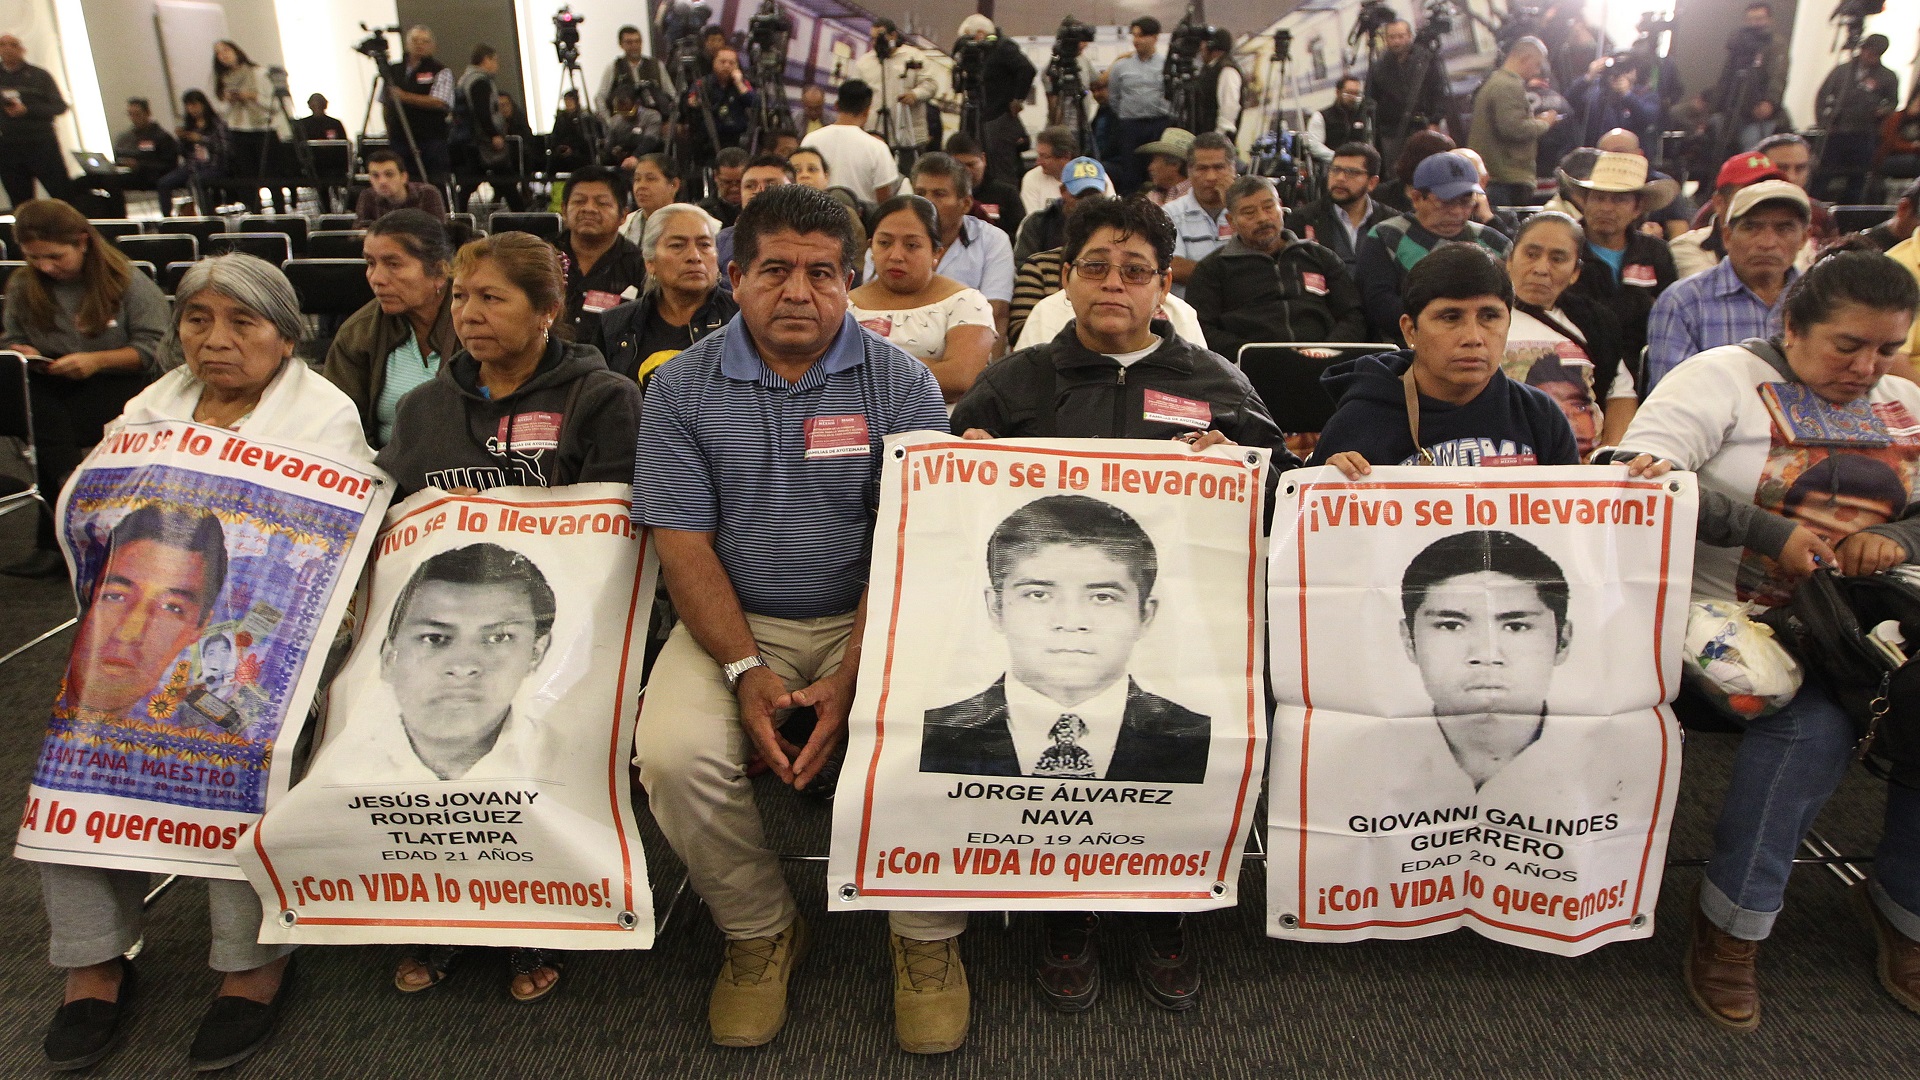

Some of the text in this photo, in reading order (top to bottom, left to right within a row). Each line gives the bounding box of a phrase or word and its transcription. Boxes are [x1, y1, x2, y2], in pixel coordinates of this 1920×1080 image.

[176, 426, 213, 456] lo
[219, 438, 371, 500] llevaron!
[912, 452, 1246, 502] ¡Vivo se lo llevaron!
[423, 512, 446, 536] se
[458, 506, 488, 533] lo
[498, 508, 637, 540] llevaron!
[1311, 494, 1657, 532] ¡Vivo se lo llevaron!
[46, 744, 236, 787] SANTANA MAESTRO
[71, 770, 84, 780] de
[174, 784, 200, 795] años
[948, 782, 1173, 804] JORGE ÁLVAREZ
[348, 791, 539, 809] JESÚS JOVANY
[45, 801, 78, 834] lo
[370, 808, 523, 826] RODRÍGUEZ
[1022, 809, 1093, 825] NAVA
[1349, 805, 1618, 839] GIOVANNI GALINDES
[382, 848, 533, 861] EDAD 21 AÑOS
[387, 831, 517, 846] TLATEMPA
[967, 832, 1145, 846] EDAD 19 AÑOS
[1410, 826, 1564, 860] GUERRERO
[876, 847, 1210, 881] ¡Con VIDA lo queremos!
[1402, 850, 1577, 882] EDAD 20 AÑOS
[294, 873, 611, 910] ¡Con VIDA lo queremos!
[1319, 871, 1627, 923] ¡Con VIDA lo queremos!
